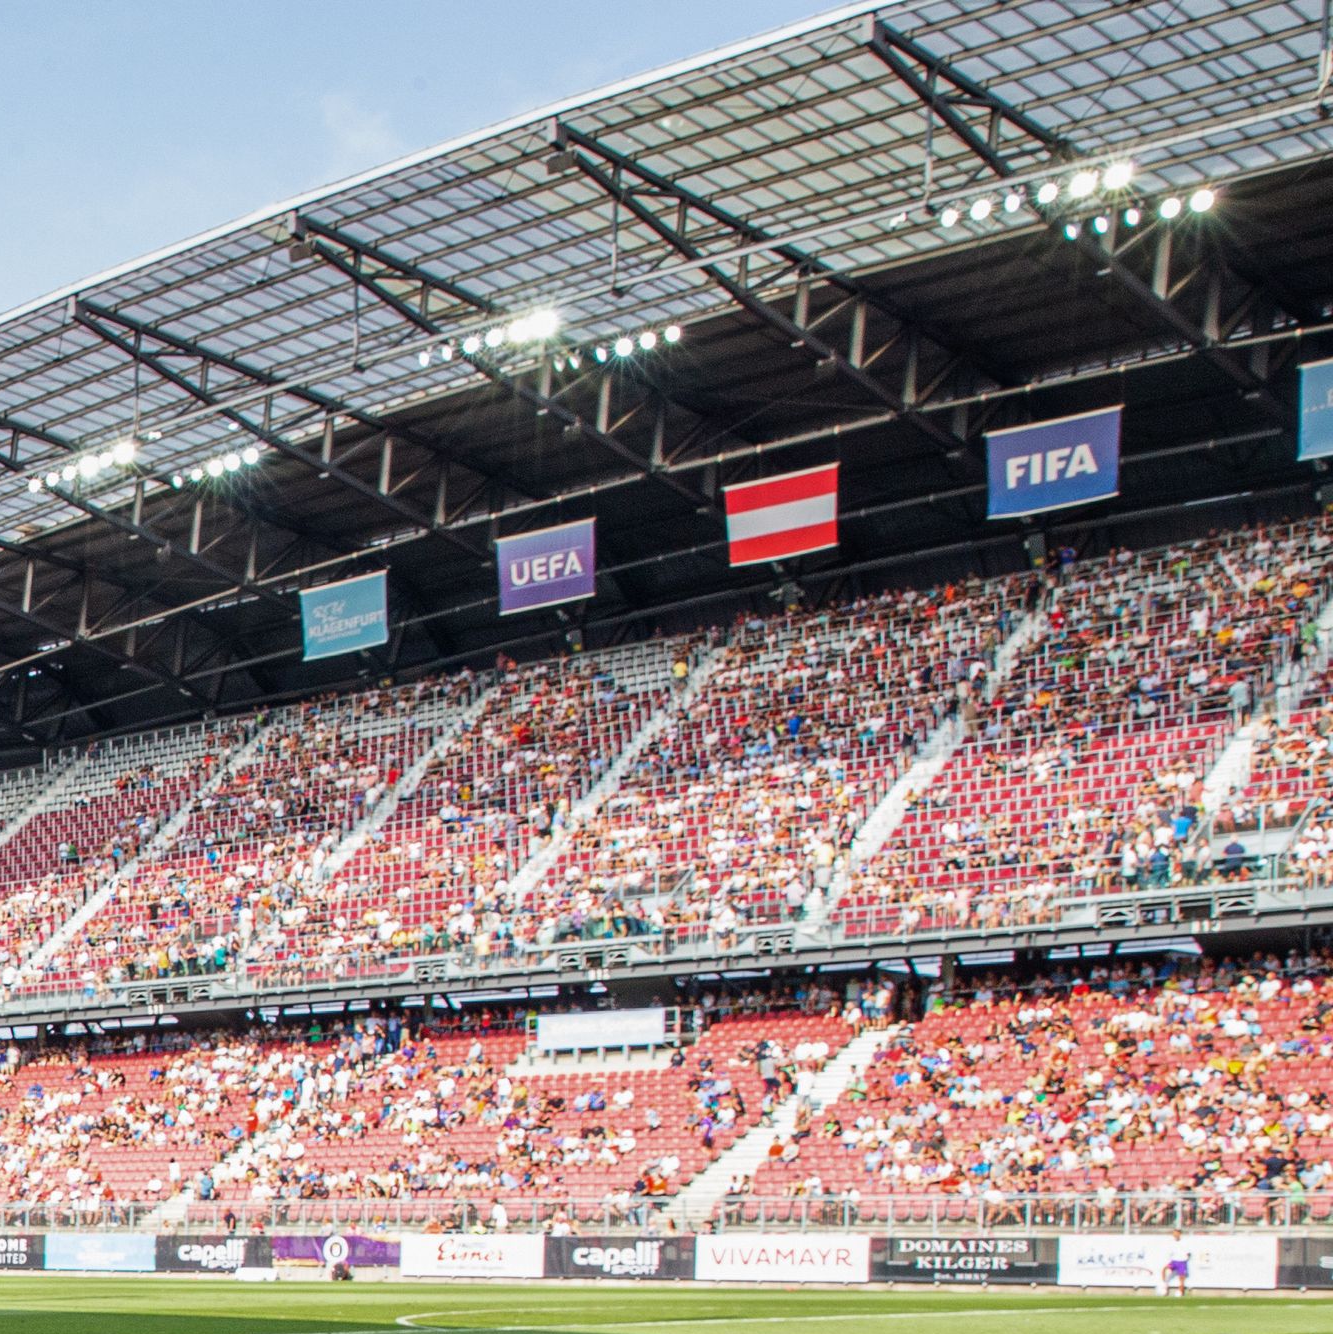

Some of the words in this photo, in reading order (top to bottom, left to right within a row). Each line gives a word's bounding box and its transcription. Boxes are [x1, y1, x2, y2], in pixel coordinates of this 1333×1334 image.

[1006, 443, 1098, 490] FIFA
[510, 551, 582, 587] UEFA
[177, 1239, 245, 1267] capelli
[573, 1241, 661, 1272] capelli
[711, 1247, 853, 1267] VIVAMAYR
[899, 1240, 1029, 1253] DOMAINES
[611, 1265, 659, 1275] SPORT
[916, 1256, 1009, 1270] KILGER
